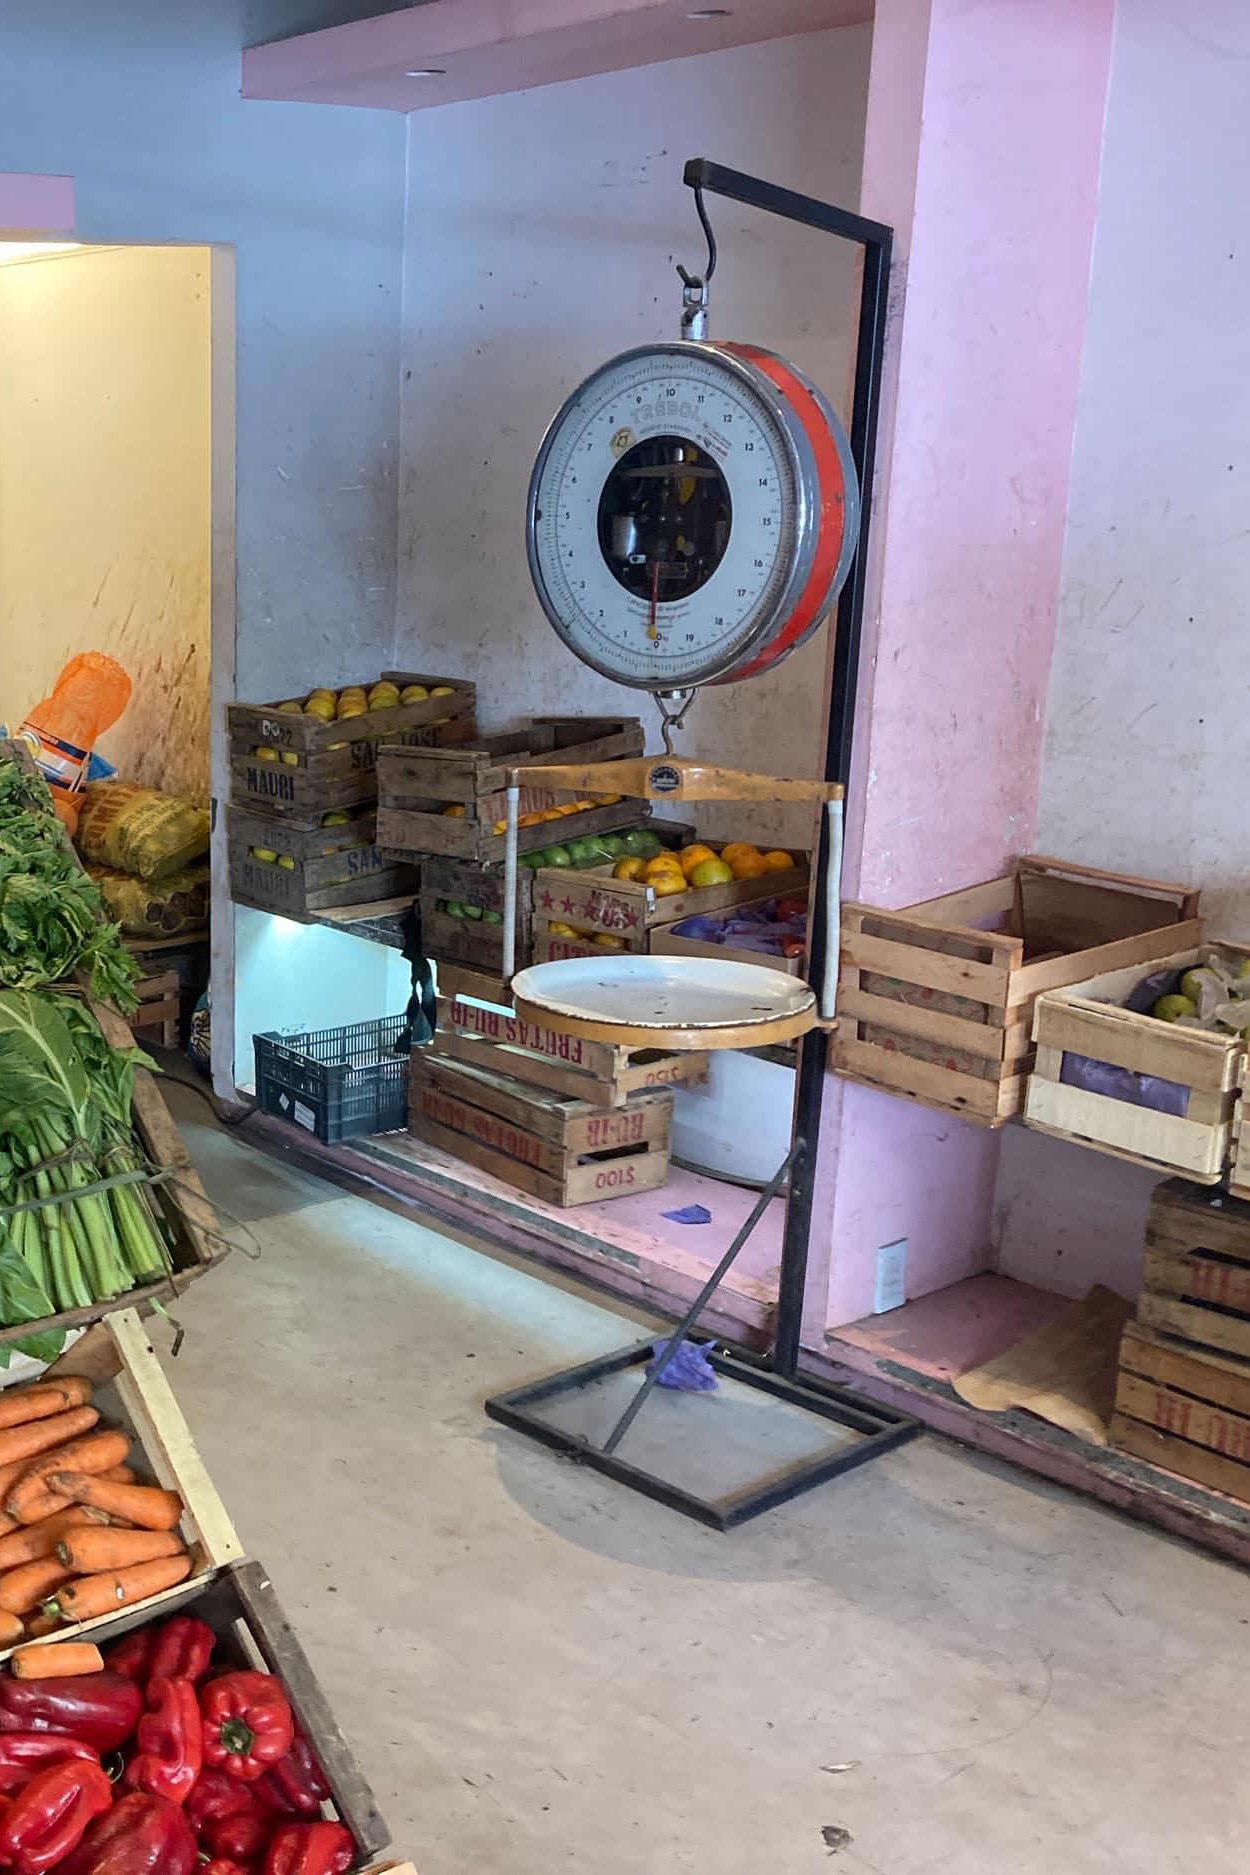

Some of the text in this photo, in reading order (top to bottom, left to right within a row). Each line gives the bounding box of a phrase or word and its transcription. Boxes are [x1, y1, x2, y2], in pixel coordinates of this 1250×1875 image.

[666, 388, 676, 397] 10
[698, 395, 705, 403] 11
[723, 414, 733, 423] 12
[745, 443, 754, 451] 13
[758, 478, 768, 487] 14
[762, 517, 771, 526] 15
[754, 559, 763, 568] 16
[737, 589, 746, 597] 17
[715, 617, 724, 626] 18
[685, 633, 695, 642] 19
[246, 766, 295, 801] MAURI
[506, 1018, 583, 1065] FRUTAS
[595, 1166, 636, 1190] $100
